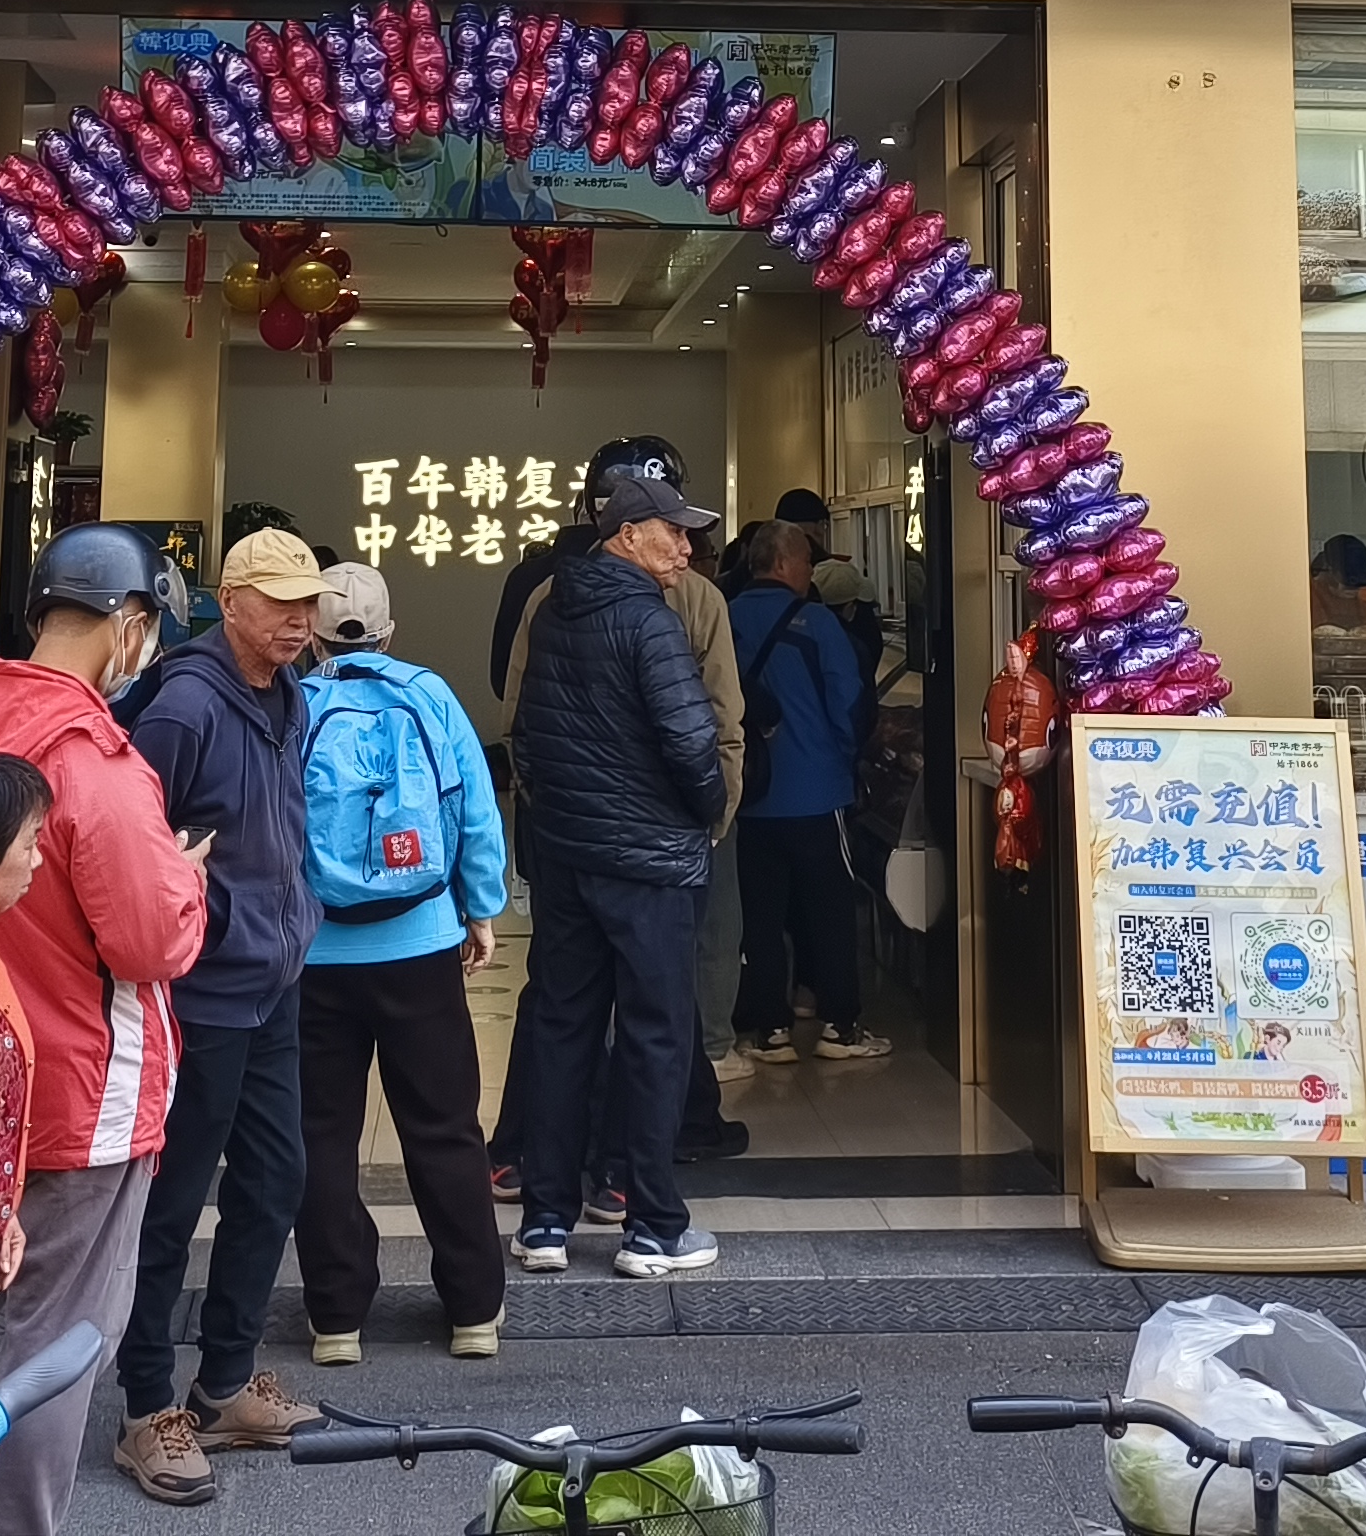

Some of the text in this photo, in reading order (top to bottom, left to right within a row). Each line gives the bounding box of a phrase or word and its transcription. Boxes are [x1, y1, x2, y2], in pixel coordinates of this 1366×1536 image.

[139, 32, 213, 53] 韓復興
[1093, 741, 1158, 760] 韓復興
[1110, 837, 1326, 876] 加韩复兴会员
